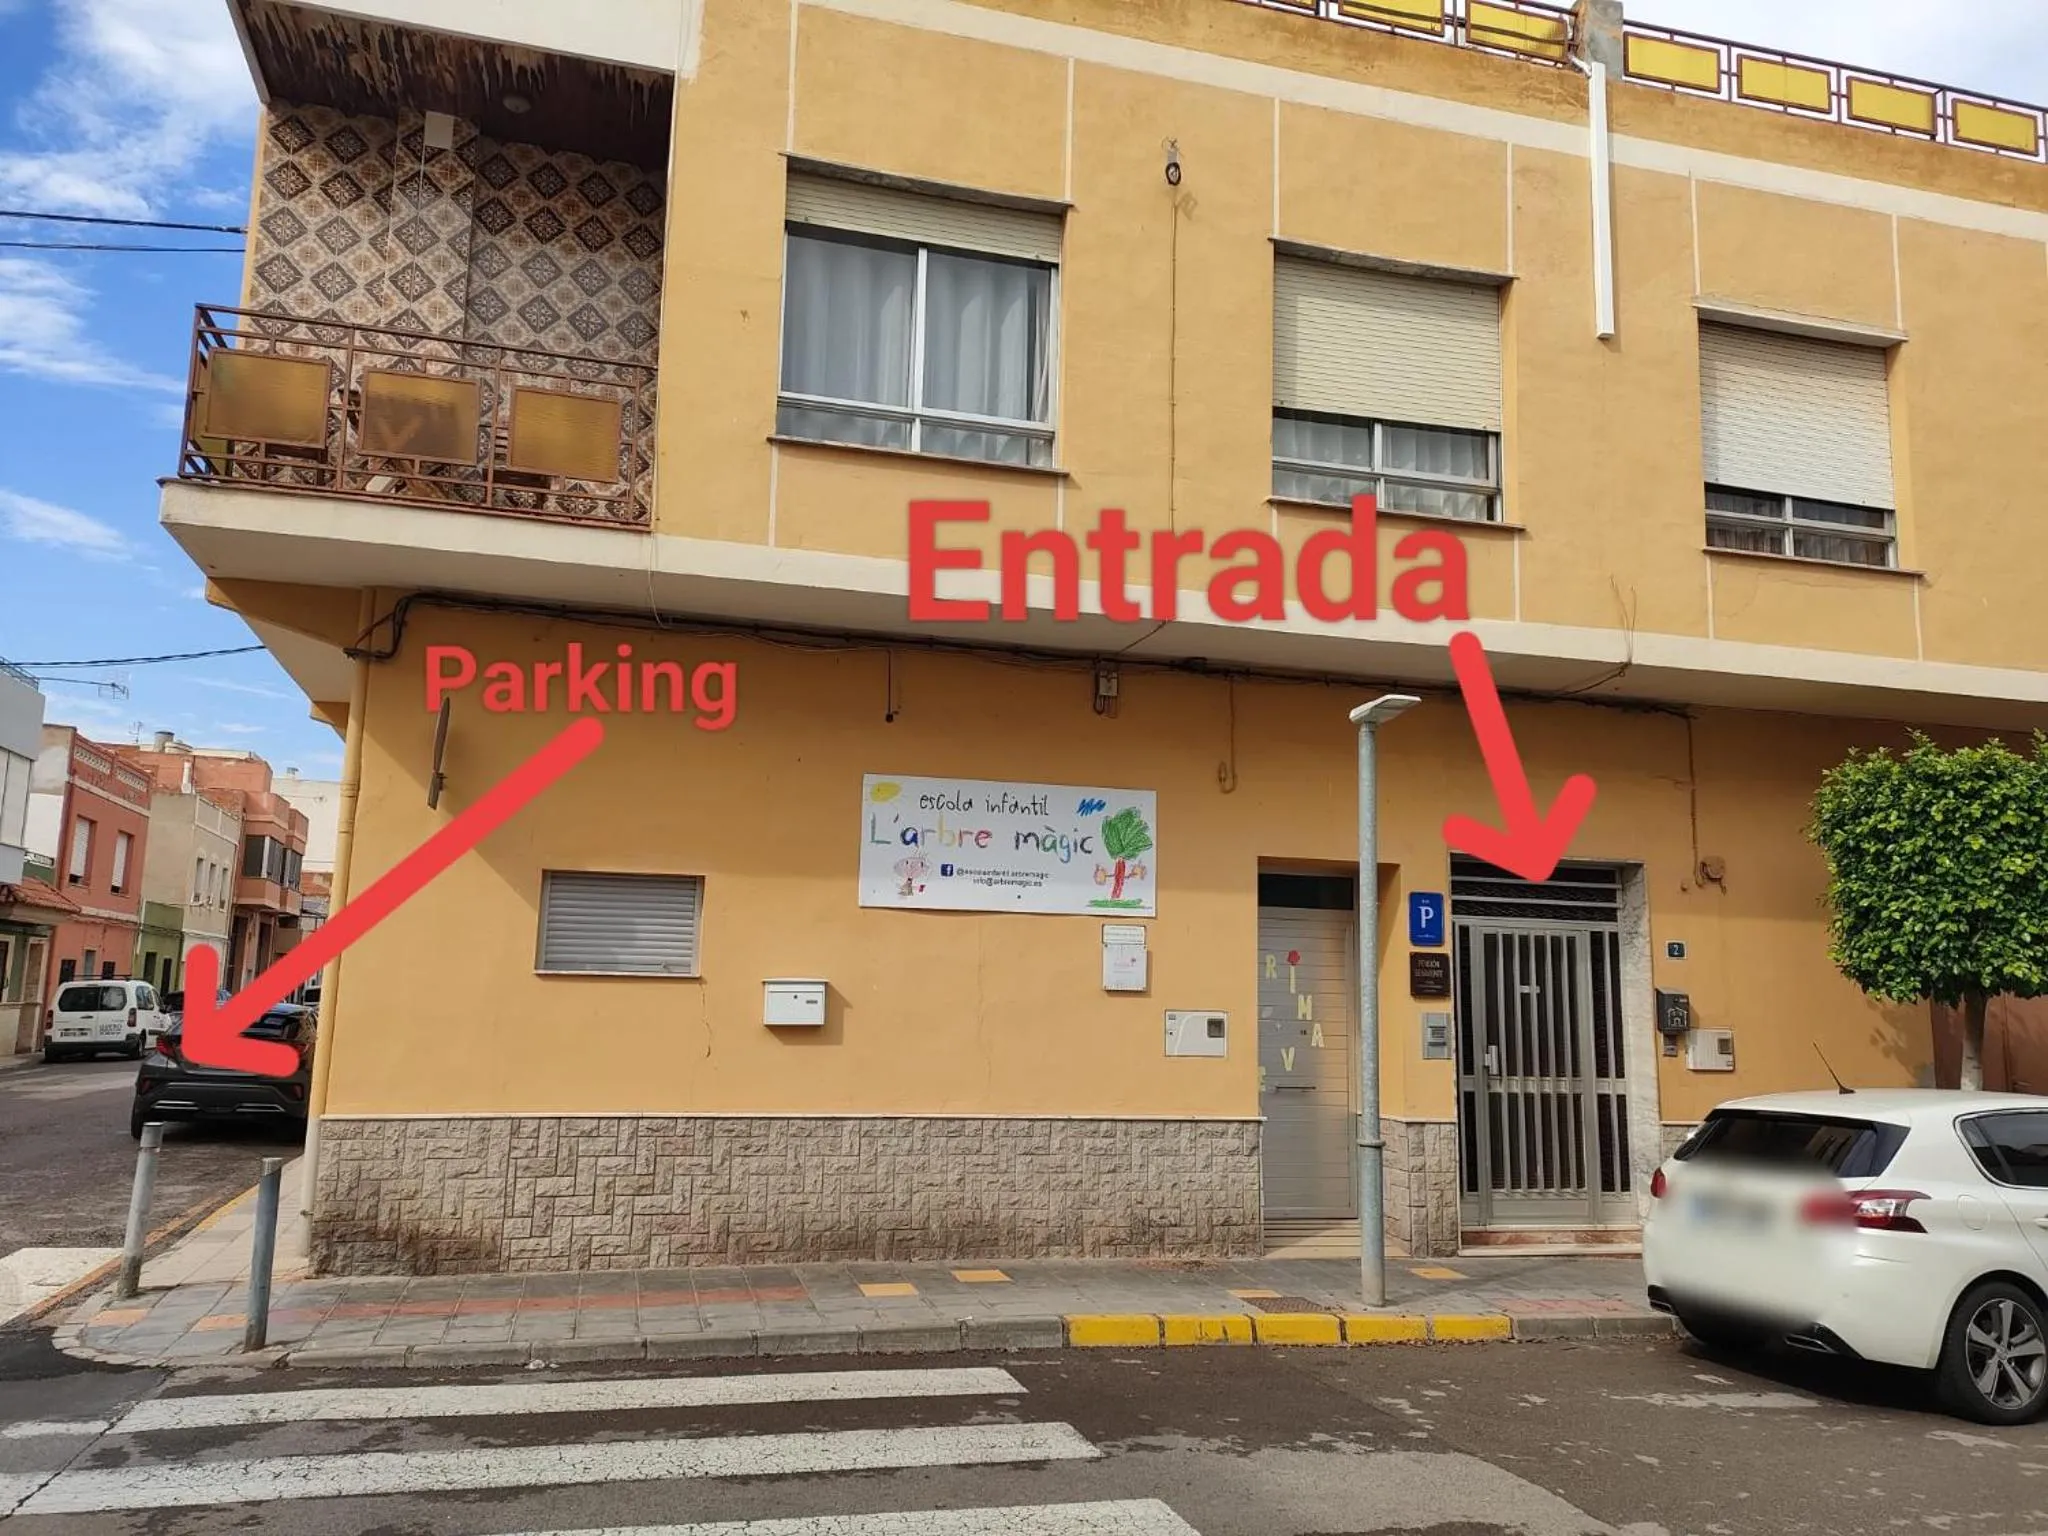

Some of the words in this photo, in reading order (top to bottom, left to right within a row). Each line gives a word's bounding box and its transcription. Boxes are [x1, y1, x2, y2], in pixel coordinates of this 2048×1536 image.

[919, 789, 973, 813] escola
[870, 811, 993, 848] L'arbre
[1014, 824, 1094, 863] màgic
[1417, 905, 1434, 929] P
